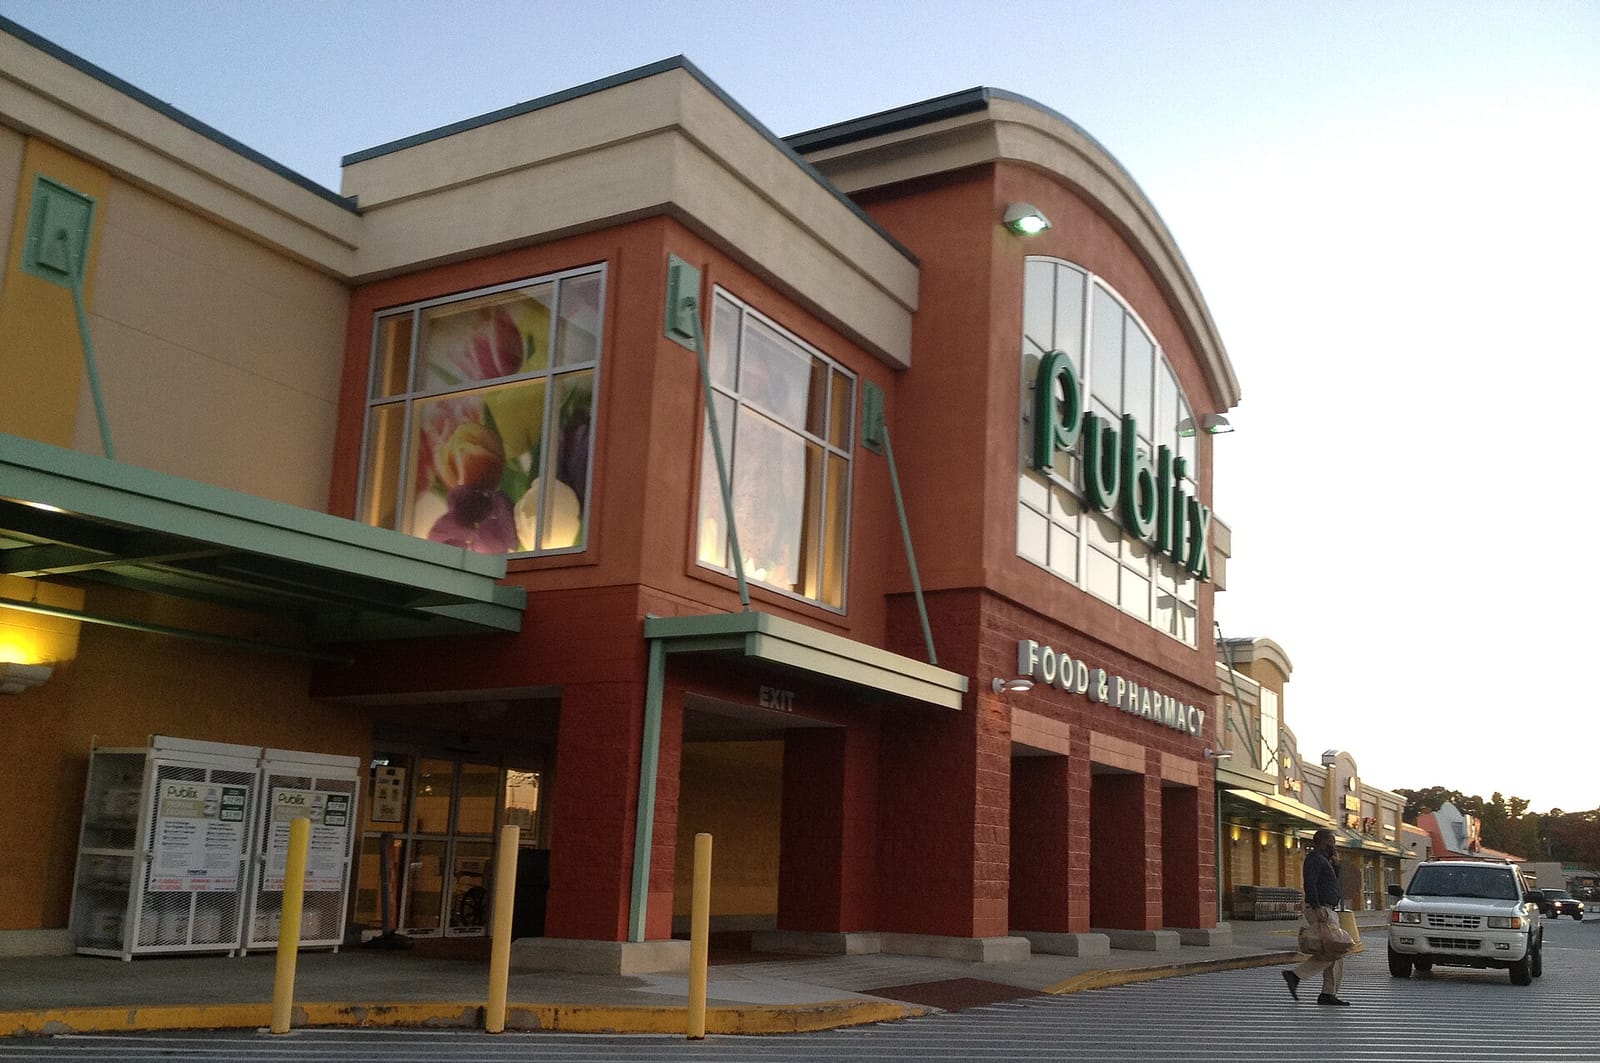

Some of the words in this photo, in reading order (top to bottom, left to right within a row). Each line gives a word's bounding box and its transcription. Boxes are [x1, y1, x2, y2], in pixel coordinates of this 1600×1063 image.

[1034, 350, 1211, 582] Publix
[759, 685, 795, 712] EXIT
[1018, 639, 1089, 694] FOOD
[1089, 668, 1108, 702] &
[1108, 675, 1205, 737] PHARMACY
[167, 785, 199, 799] Publix
[278, 792, 305, 805] Publix
